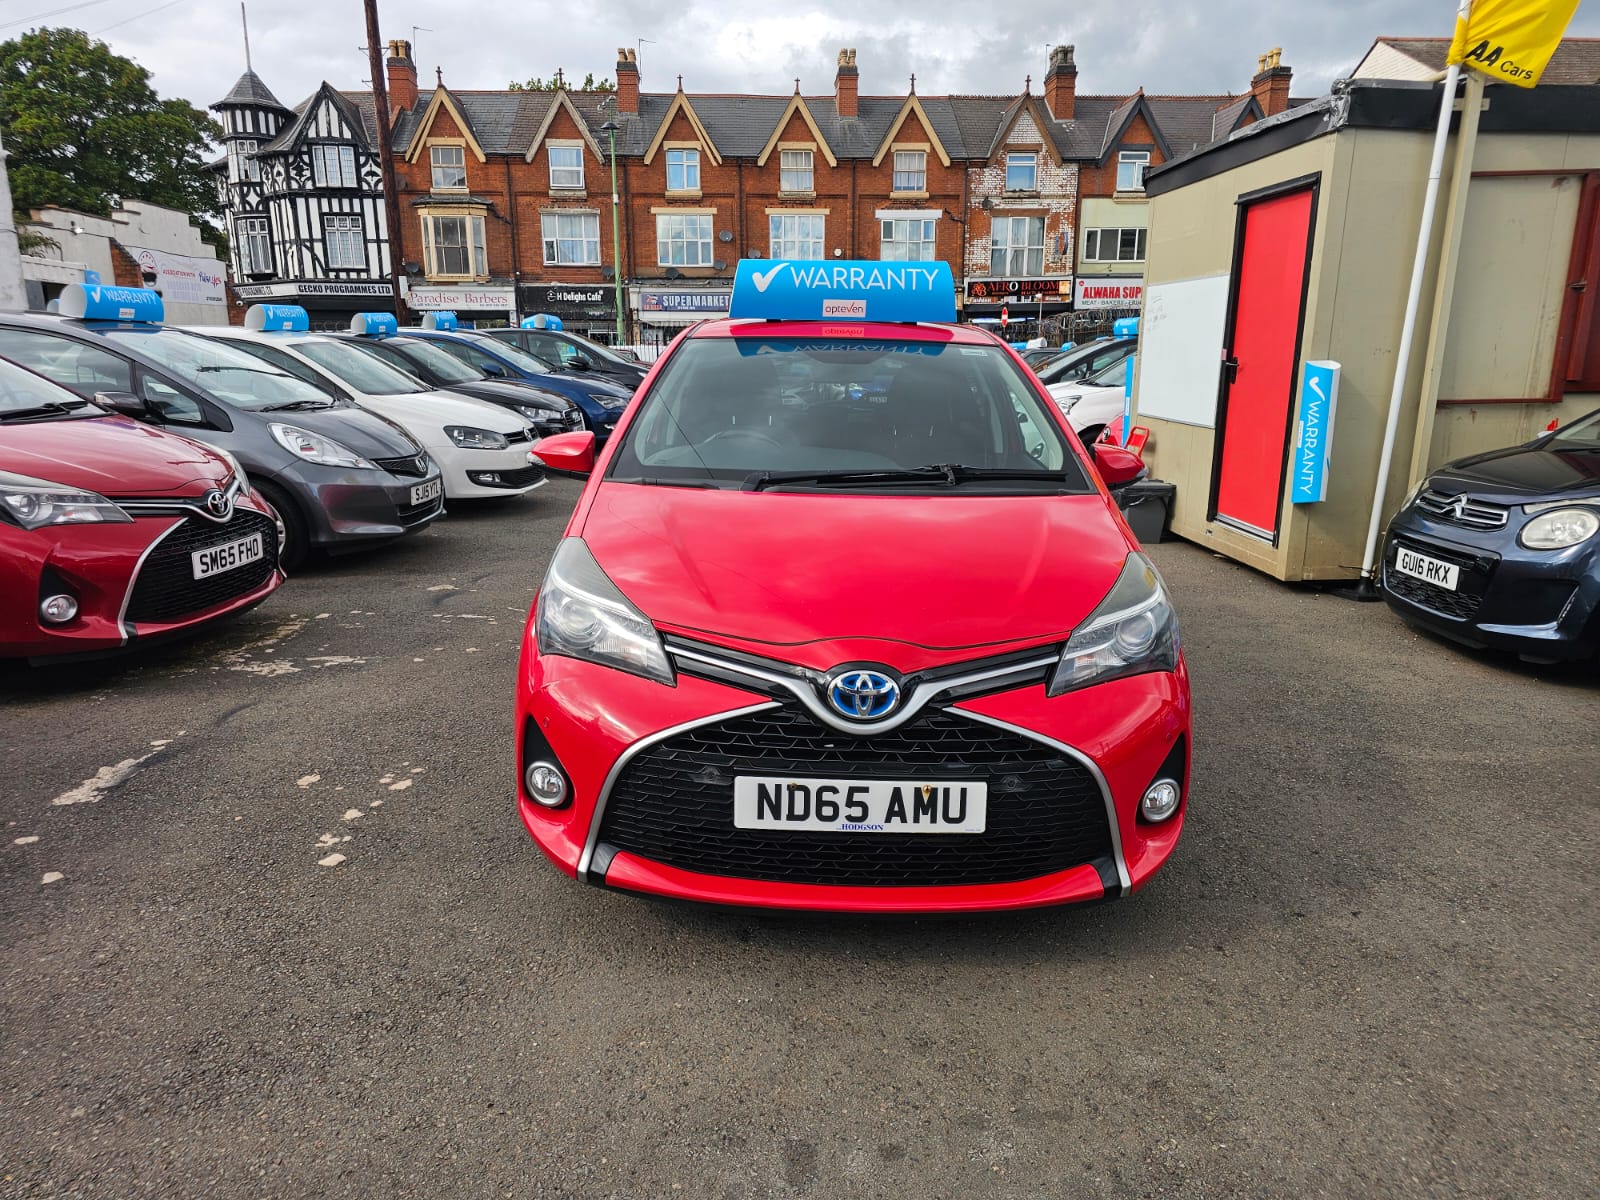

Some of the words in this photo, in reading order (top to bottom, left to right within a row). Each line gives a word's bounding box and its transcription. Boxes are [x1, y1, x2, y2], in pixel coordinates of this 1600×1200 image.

[1464, 39, 1504, 67] AA
[1500, 60, 1533, 80] Cars
[790, 266, 939, 291] WARRANTY
[1021, 280, 1059, 291] BLOOM
[103, 289, 156, 305] WARRANTY
[298, 284, 323, 294] GECKO
[324, 284, 377, 295] PROGRAMMES
[378, 285, 391, 295] LTD
[411, 291, 460, 304] Paradise
[464, 292, 508, 304] Barbers
[1083, 286, 1121, 299] ALWAHA
[1122, 286, 1143, 299] SUP
[662, 295, 730, 307] SUPERMARKET
[825, 302, 864, 314] opteven
[1300, 400, 1322, 495] WARRANTY
[415, 485, 429, 501] SJ15
[430, 482, 439, 496] YTL
[200, 550, 236, 574] SM65
[237, 541, 259, 562] FHO
[1401, 554, 1424, 575] GU16
[1426, 561, 1451, 584] RKX
[757, 783, 870, 823] ND65
[884, 786, 968, 824] AMU
[841, 823, 884, 831] HODGSON
